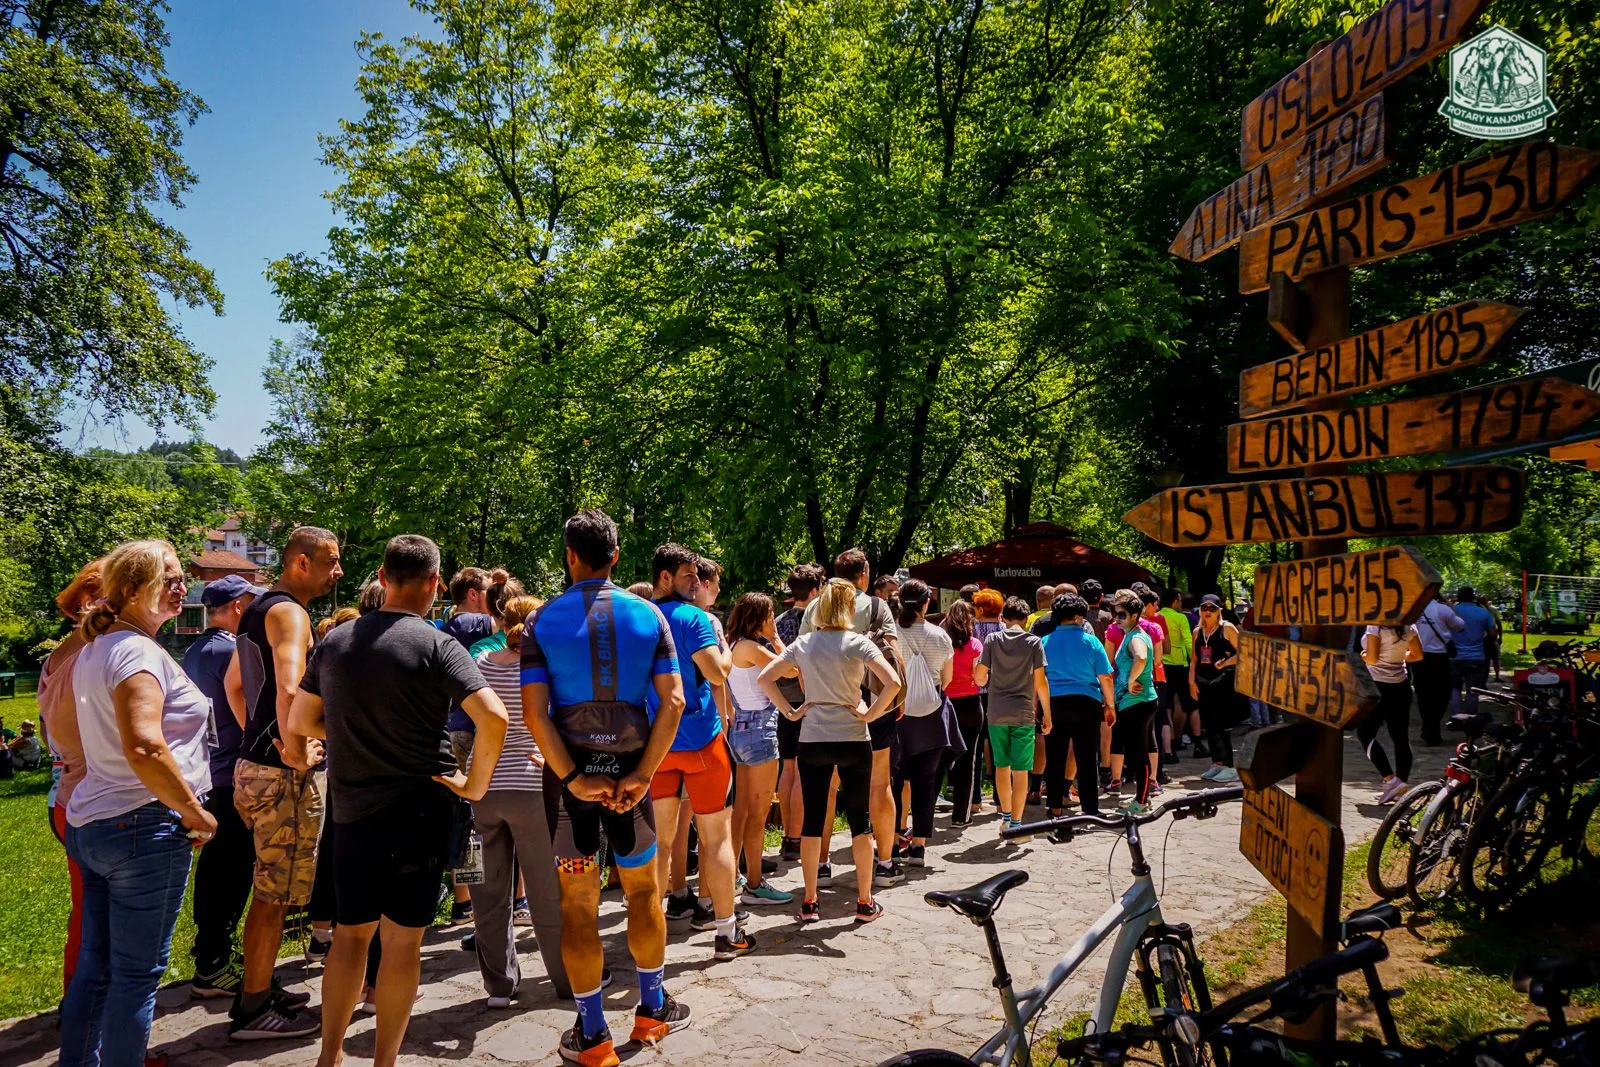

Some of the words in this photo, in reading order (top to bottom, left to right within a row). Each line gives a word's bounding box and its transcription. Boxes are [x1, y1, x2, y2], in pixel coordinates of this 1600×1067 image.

[1190, 163, 1275, 261] ATINA
[1266, 142, 1560, 284] PARIS-1530
[1239, 405, 1390, 469] LONDON
[1437, 380, 1561, 448] 1794
[1171, 466, 1521, 543] ISTANBUL-1349
[994, 567, 1041, 578] Karlovačko
[1257, 550, 1404, 624] ZAGREB-155
[599, 662, 613, 687] BK
[1252, 637, 1346, 723] WIEN-515
[590, 733, 617, 741] KAYAK
